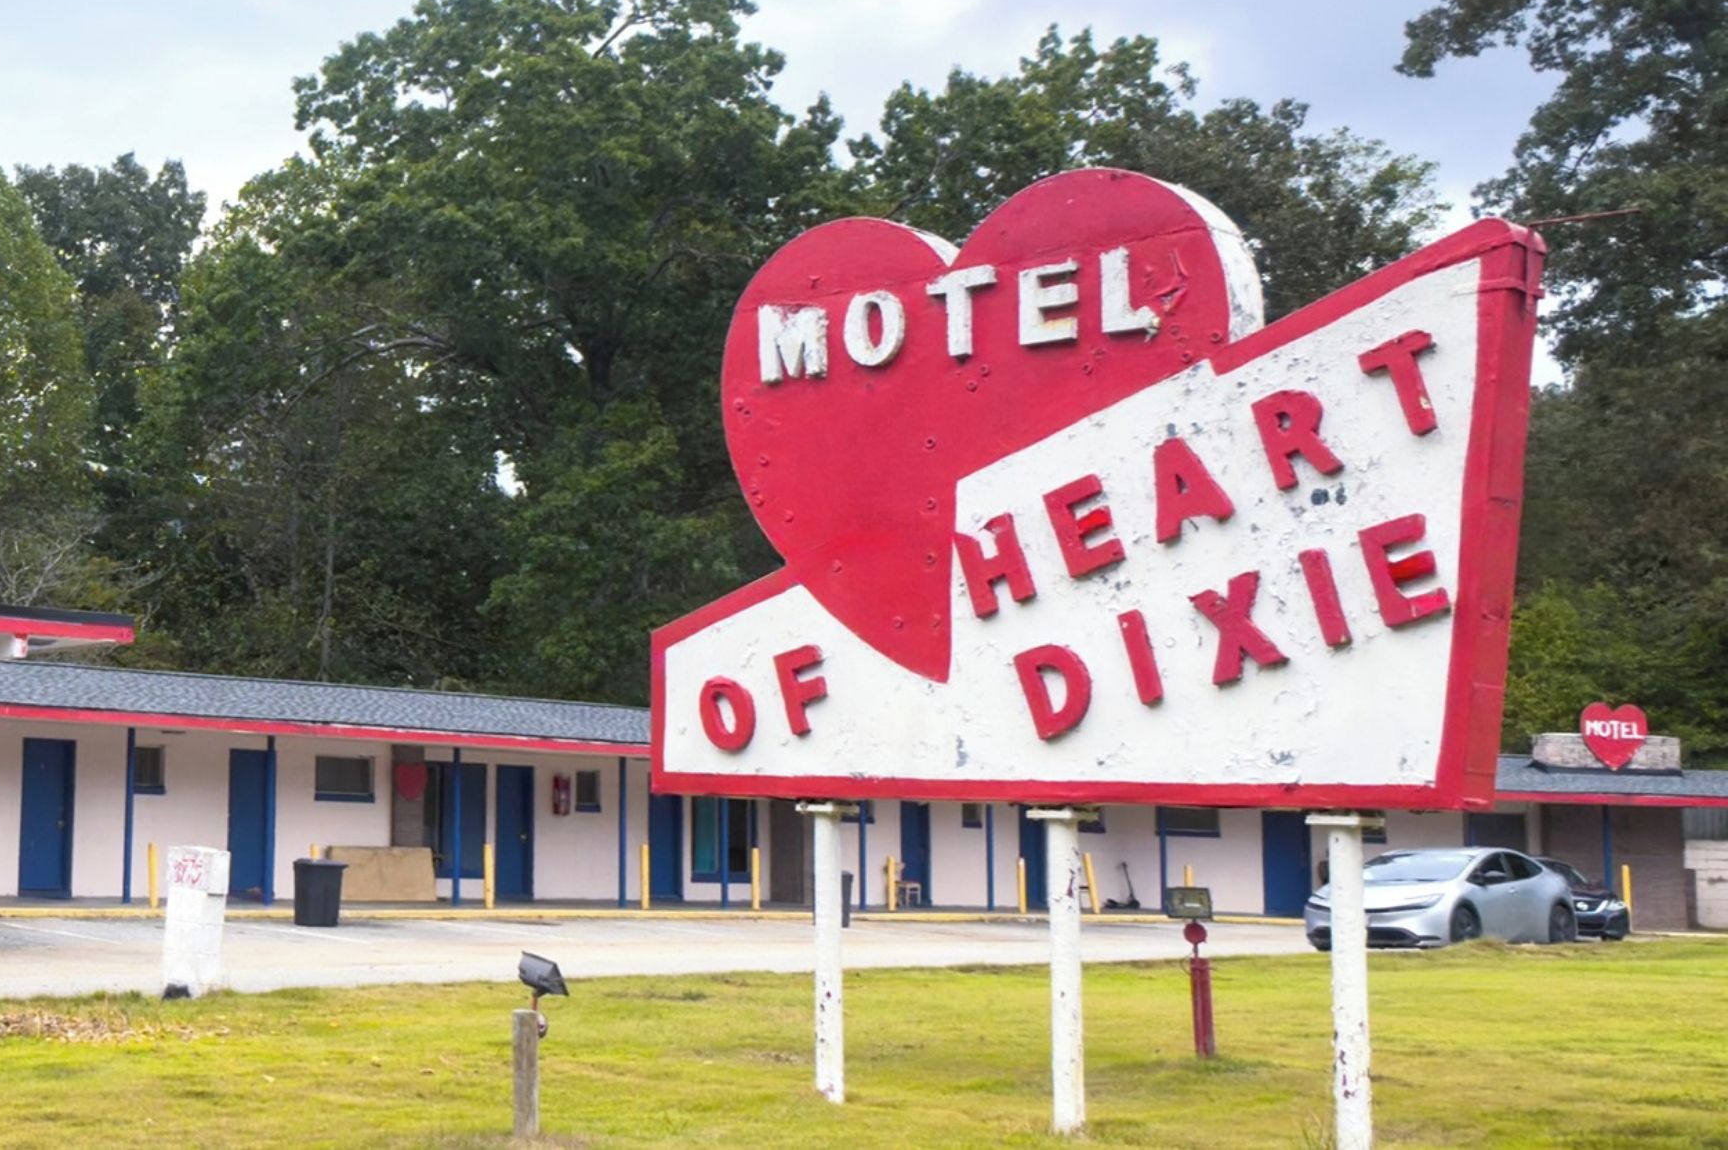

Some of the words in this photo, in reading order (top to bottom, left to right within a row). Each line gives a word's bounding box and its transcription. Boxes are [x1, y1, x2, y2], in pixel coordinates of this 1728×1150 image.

[757, 246, 1161, 384] MOTEL
[953, 328, 1437, 618] HEART
[699, 644, 829, 754] OF
[1013, 512, 1451, 742] DIXIE
[1585, 720, 1645, 740] MOTEL
